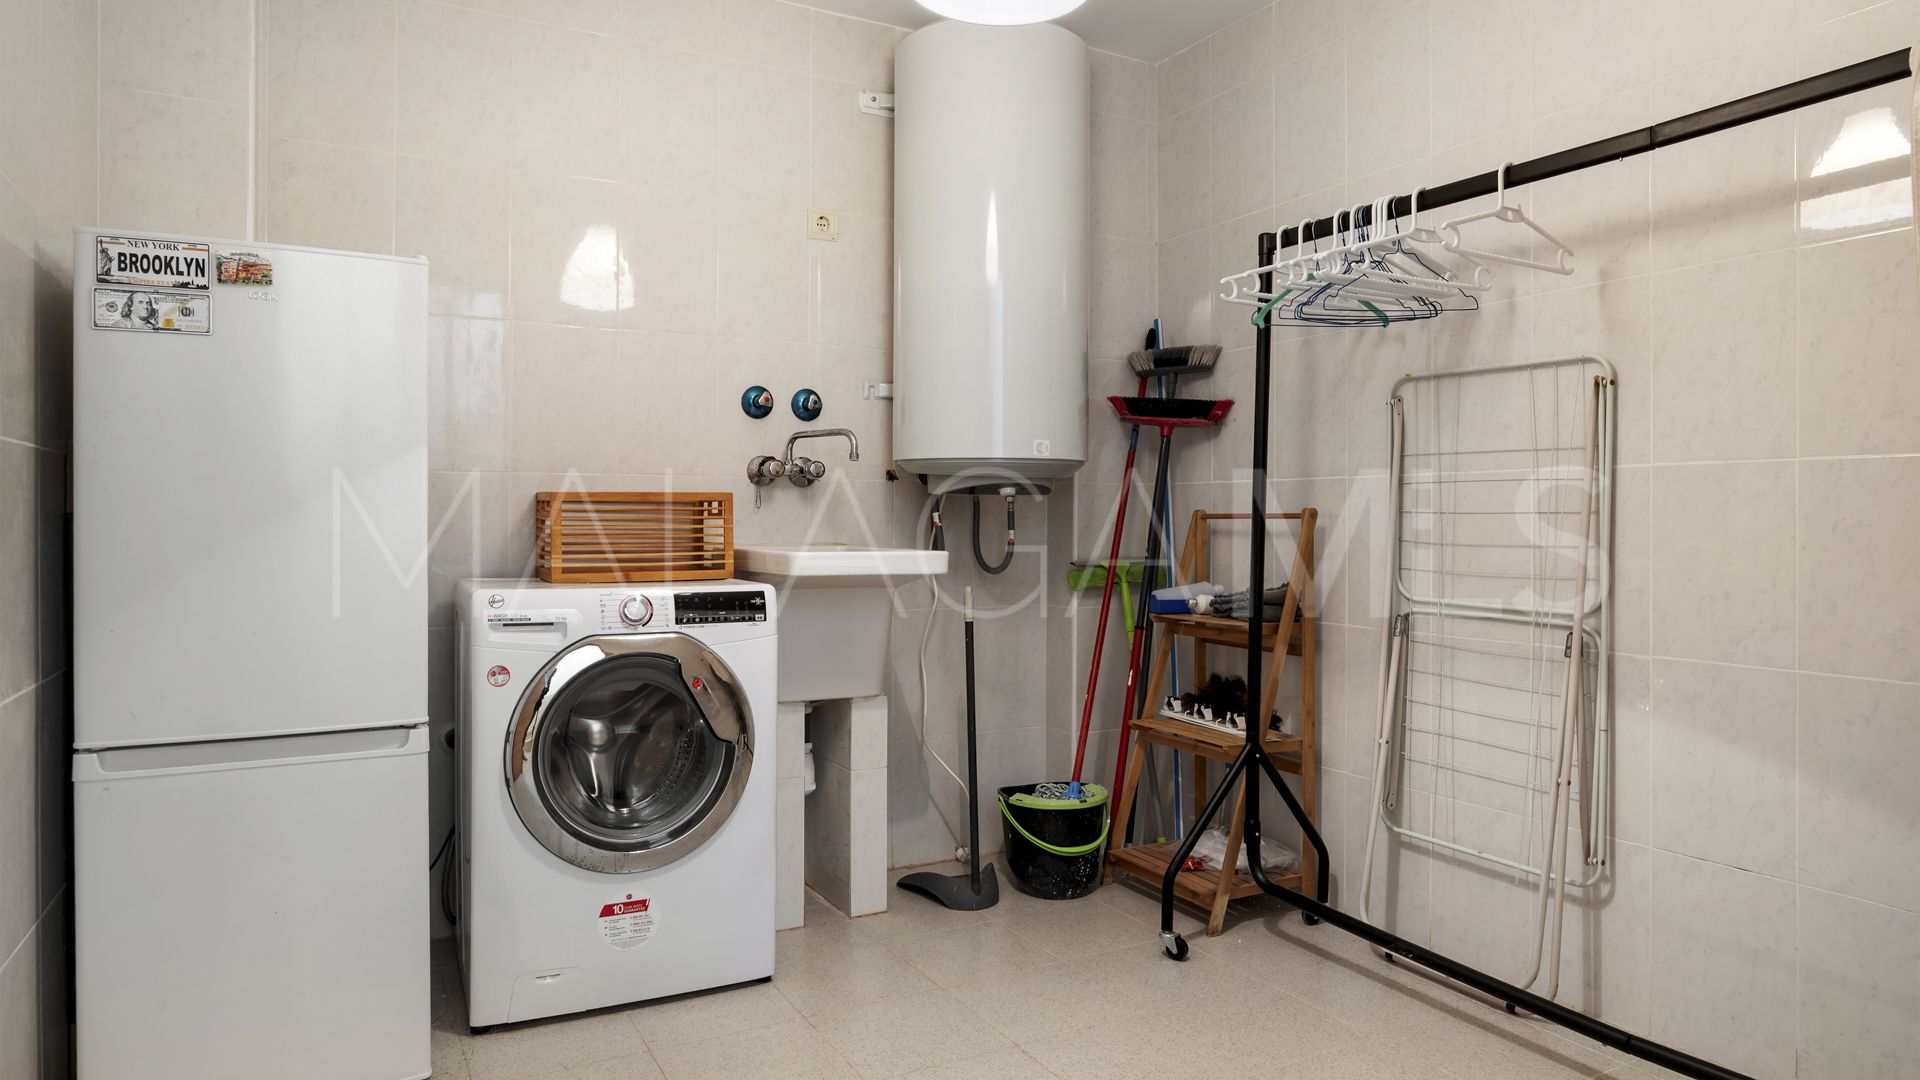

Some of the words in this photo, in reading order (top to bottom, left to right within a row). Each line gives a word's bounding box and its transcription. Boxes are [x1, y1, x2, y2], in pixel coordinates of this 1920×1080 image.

[127, 240, 151, 249] NEW
[152, 242, 180, 251] YORK
[117, 252, 206, 278] BROOKLYN
[612, 904, 624, 914] 10
